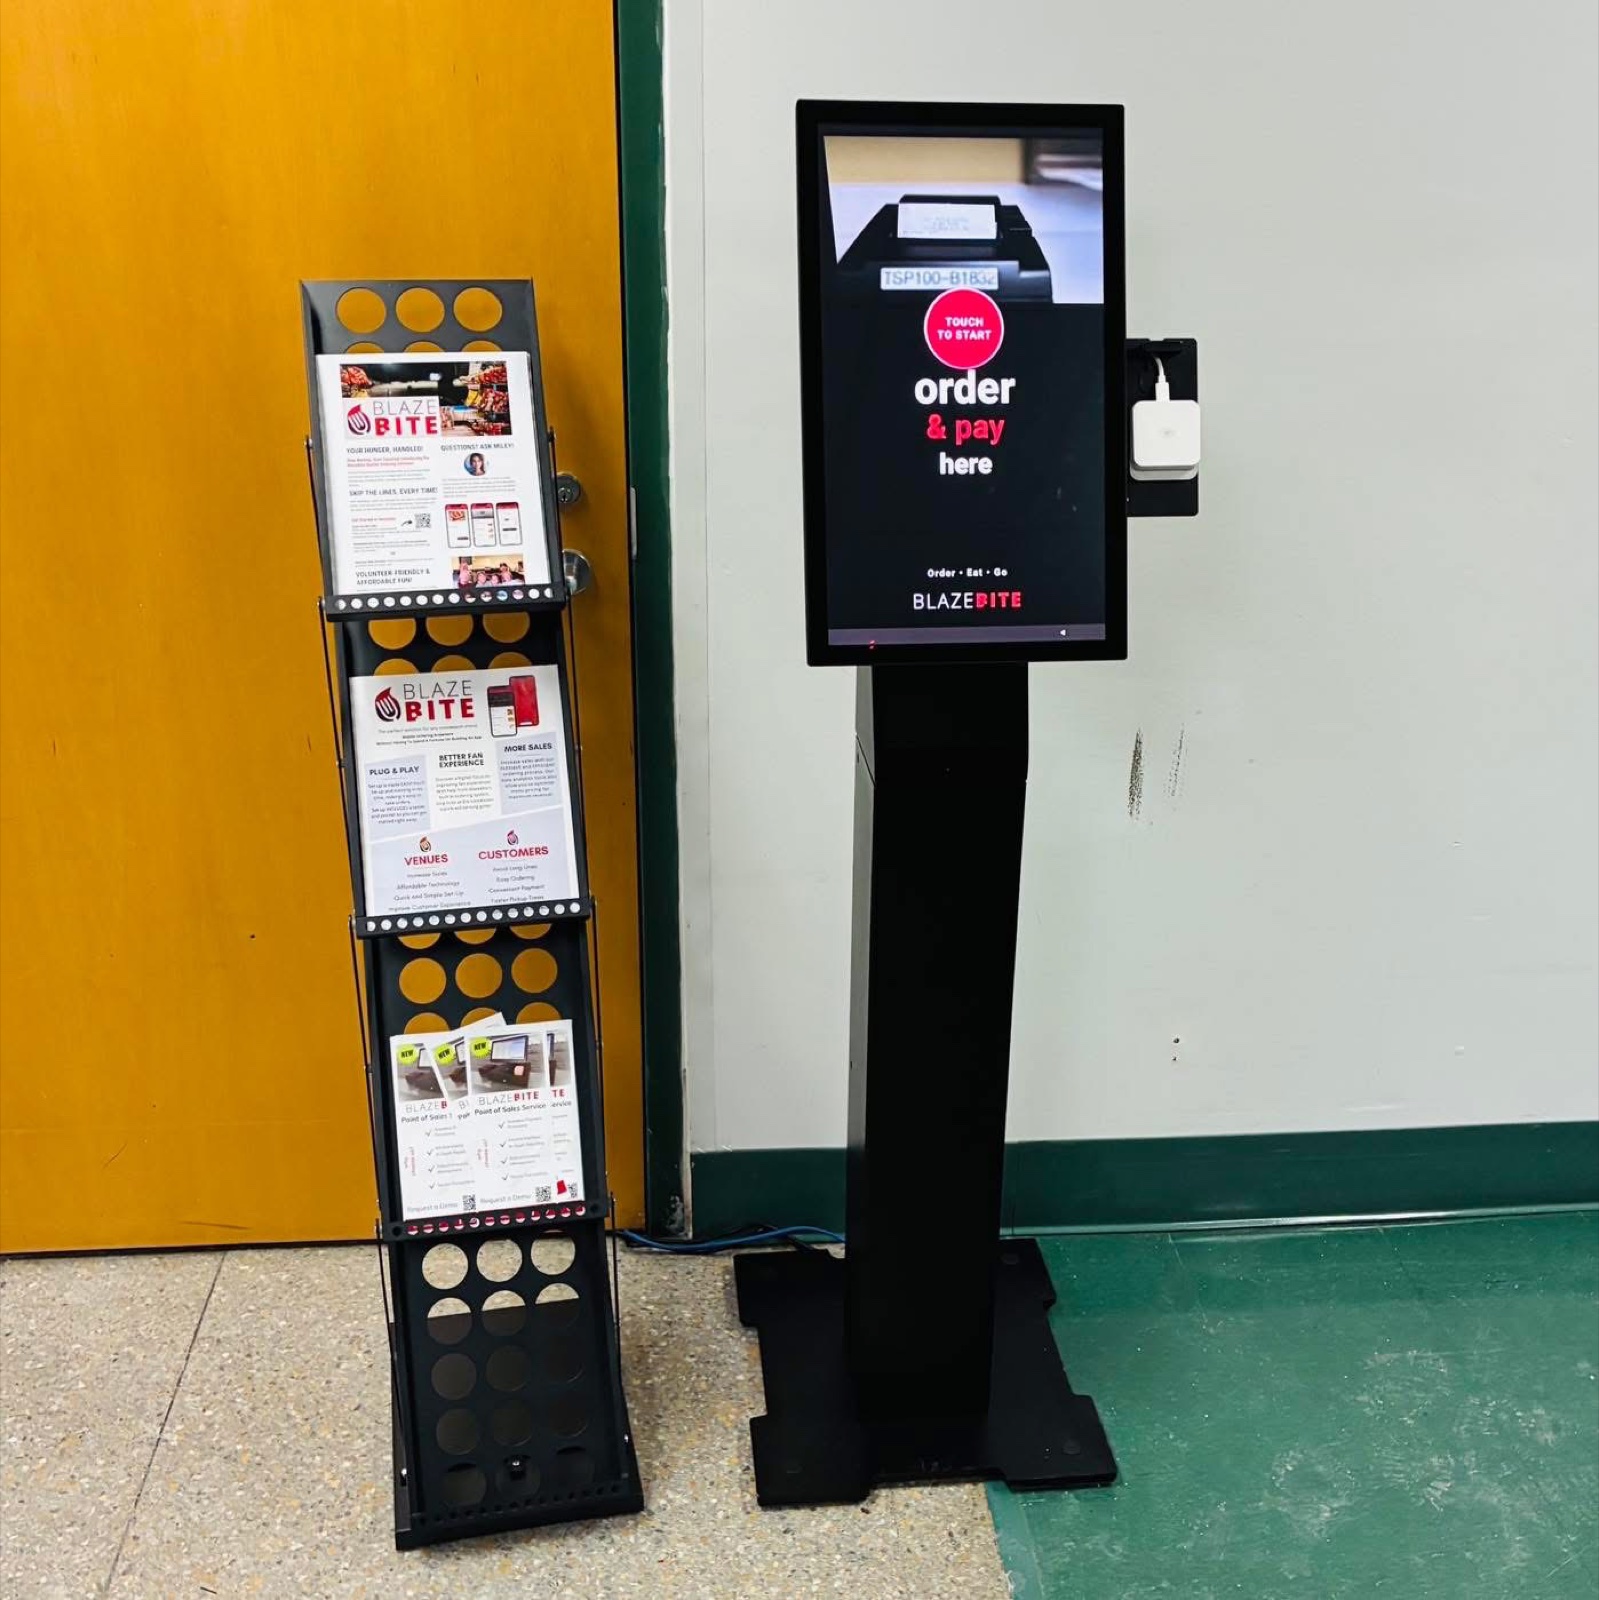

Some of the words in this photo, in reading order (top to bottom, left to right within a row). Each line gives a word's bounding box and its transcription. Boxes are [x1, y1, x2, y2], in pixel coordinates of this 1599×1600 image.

[945, 317, 984, 327] TOUCH
[937, 330, 952, 340] TO
[956, 330, 992, 340] START
[914, 368, 1016, 405] order
[373, 399, 438, 416] BLAZE
[374, 416, 438, 436] BITE
[927, 413, 946, 439] &
[955, 419, 1005, 446] pay
[364, 446, 392, 455] HUNGER,
[440, 444, 478, 452] QUESTIONS?
[939, 452, 993, 475] here
[927, 568, 956, 578] Order
[966, 568, 983, 577] Eat
[993, 567, 1008, 576] Go
[356, 578, 396, 586] AFFORDABLE
[913, 591, 1022, 610] BLAZEBITE
[403, 680, 473, 700] BLAZE
[404, 697, 475, 722] BITE
[504, 744, 526, 752] MORE
[528, 742, 552, 750] SALES
[438, 753, 466, 761] BETTER
[438, 759, 484, 768] EXPERIENCE
[369, 768, 390, 776] PLUG
[400, 766, 420, 774] PLAY
[478, 846, 549, 860] CUSTOMERS
[404, 854, 448, 866] VENUES
[396, 882, 427, 890] Affordable
[474, 1042, 486, 1050] NEW
[400, 1049, 414, 1058] NEW
[438, 1048, 450, 1059] NEW
[478, 1090, 540, 1106] BLAZEBITE
[405, 1100, 448, 1114] BLAZEB
[474, 1108, 492, 1116] Point
[494, 1106, 500, 1114] of
[502, 1105, 520, 1113] Sales
[522, 1103, 547, 1111] Service
